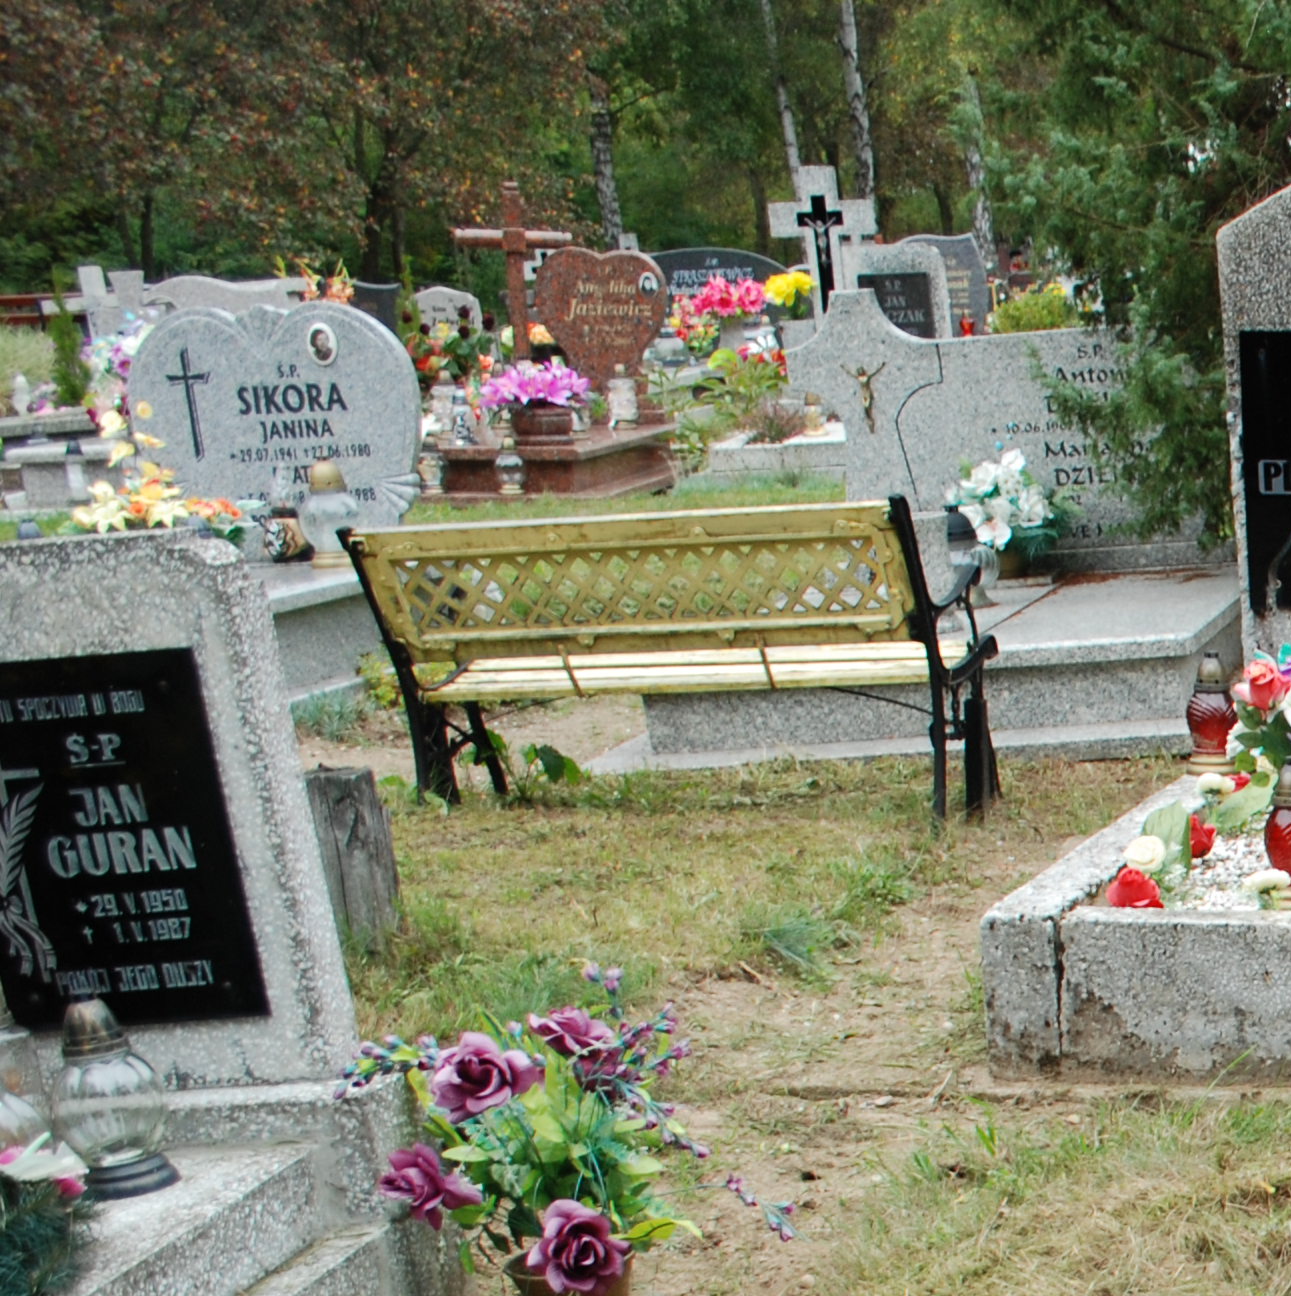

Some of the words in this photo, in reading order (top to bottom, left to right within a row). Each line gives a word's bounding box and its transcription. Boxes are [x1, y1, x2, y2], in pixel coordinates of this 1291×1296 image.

[237, 382, 348, 416] SIKORA
[260, 418, 334, 444] JANINA
[18, 693, 89, 722] SPOCZYWA
[91, 693, 107, 716] W
[110, 689, 146, 715] BOGU
[68, 783, 149, 828] JAN
[47, 825, 197, 879] GURAN
[56, 967, 112, 997] POKÓJ
[115, 963, 160, 992] JEGO
[161, 959, 214, 988] DUSZY
